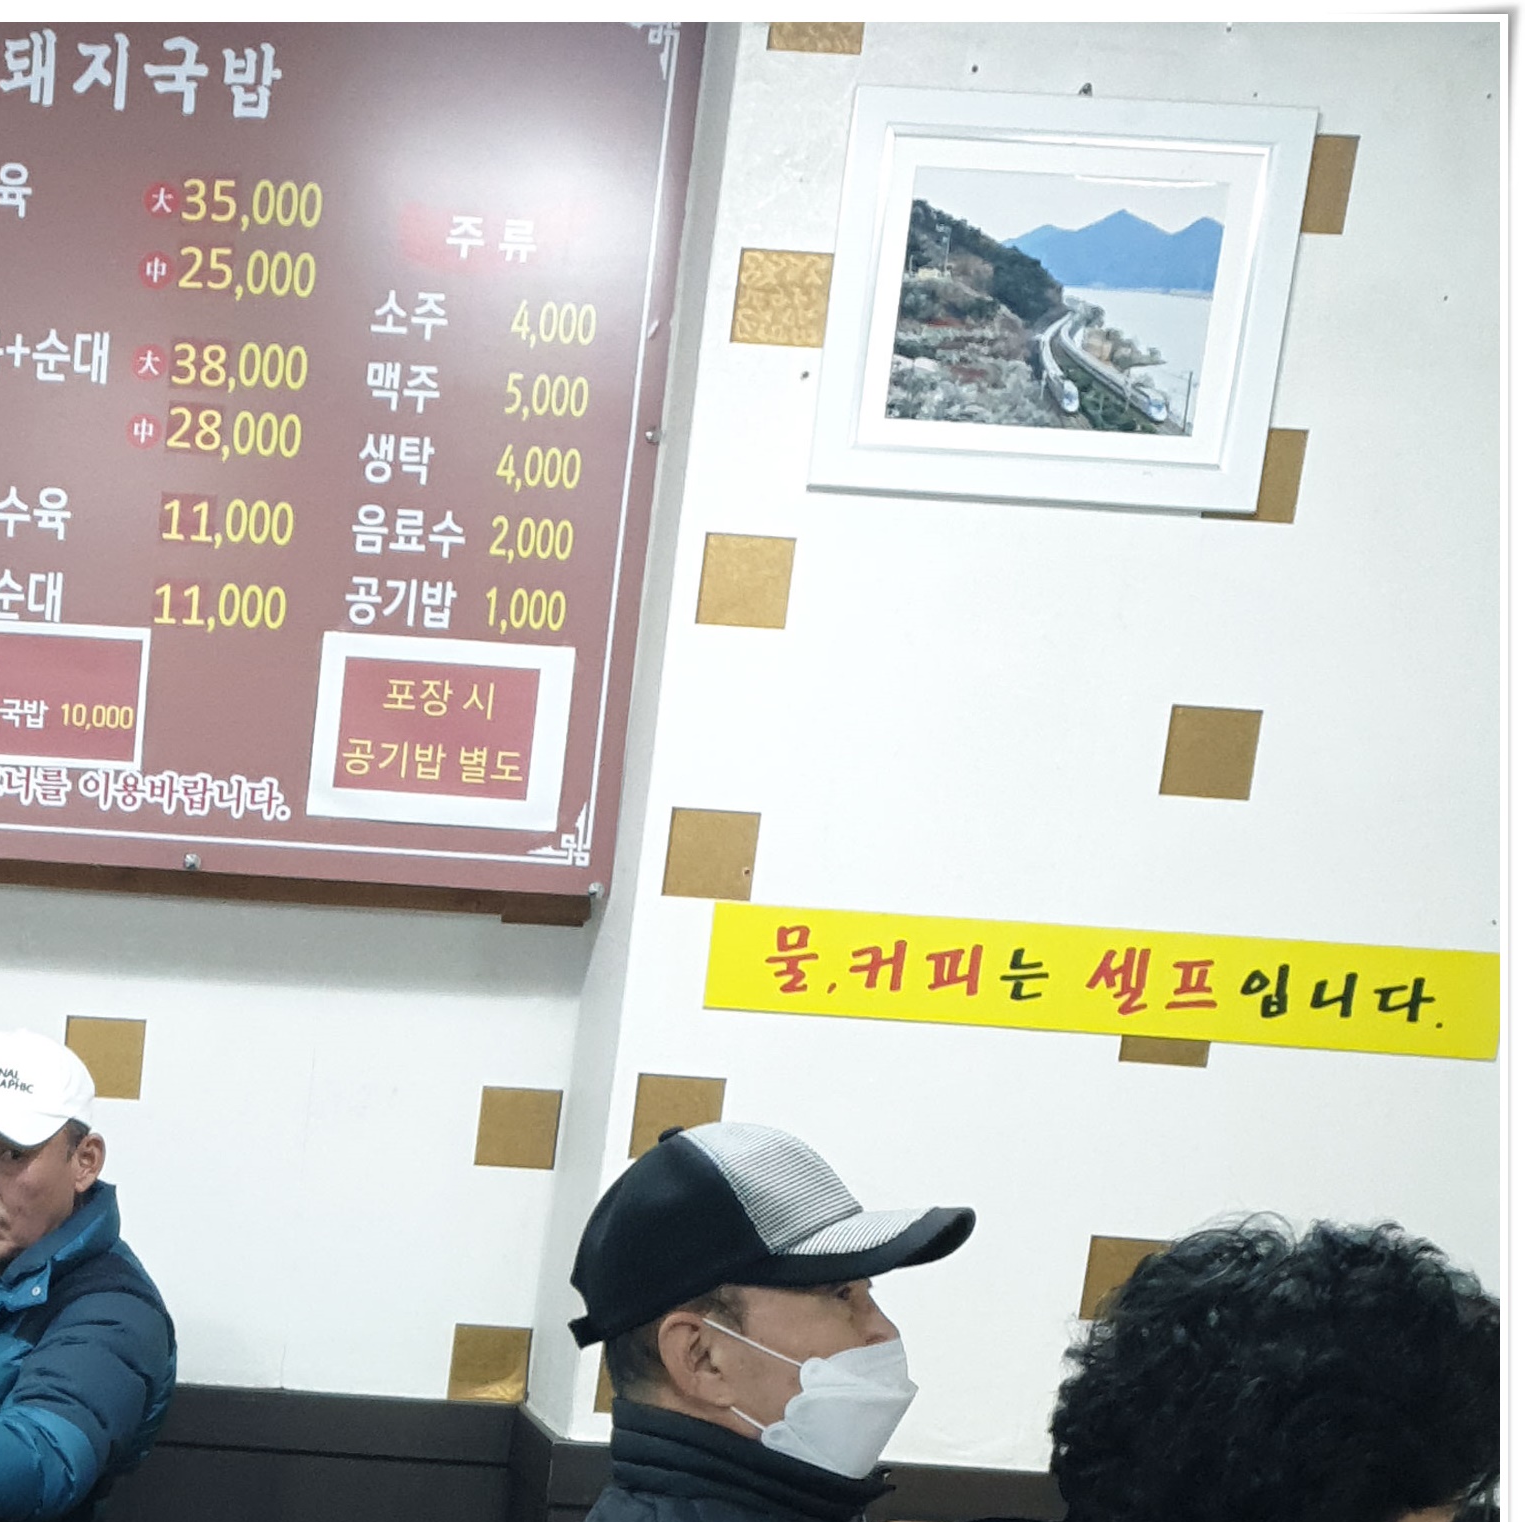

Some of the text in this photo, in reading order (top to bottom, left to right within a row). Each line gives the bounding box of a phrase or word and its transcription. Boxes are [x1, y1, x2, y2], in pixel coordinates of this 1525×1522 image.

[180, 179, 323, 232] 35,000
[178, 247, 315, 301] 25,000
[370, 289, 597, 348] 소주 4,000
[171, 344, 307, 394] 38,000
[366, 361, 588, 422] 맥주 5,000
[166, 407, 302, 462] 28,000
[359, 434, 581, 492] 생탁 4,000
[161, 499, 293, 547] 11,000
[352, 504, 573, 562] 음료수 2,000
[154, 584, 286, 632] 11,000
[345, 576, 565, 634] 공기밥 1,000
[61, 703, 133, 731] 10,000
[383, 679, 495, 720] 포장 시
[343, 737, 522, 784] 공기밥 별도
